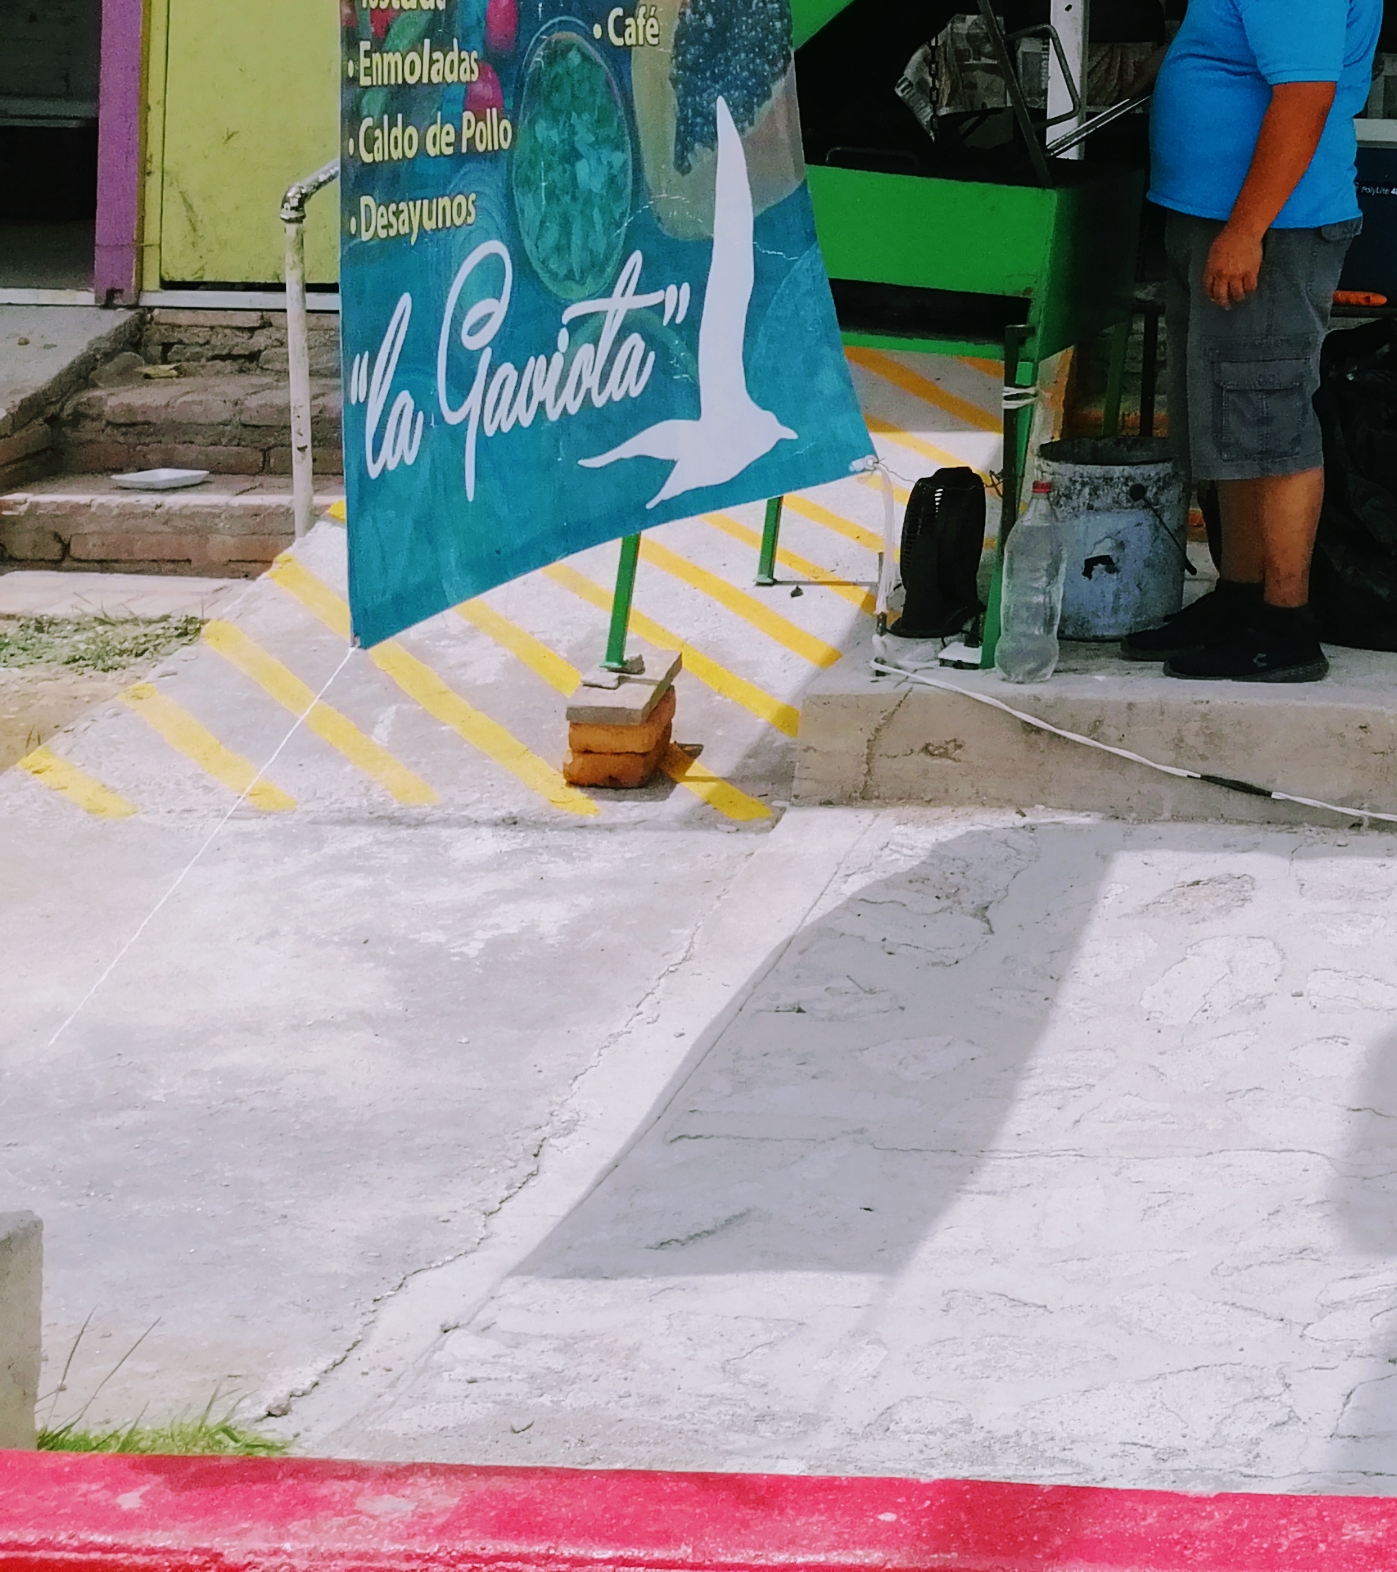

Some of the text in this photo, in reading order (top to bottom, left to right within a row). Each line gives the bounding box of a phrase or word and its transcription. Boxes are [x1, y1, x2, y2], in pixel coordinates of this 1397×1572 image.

[607, 6, 660, 46] Café
[359, 38, 480, 87] Enmoladas
[358, 108, 512, 163] Caldo de Pollo
[359, 193, 476, 246] Desayunos
